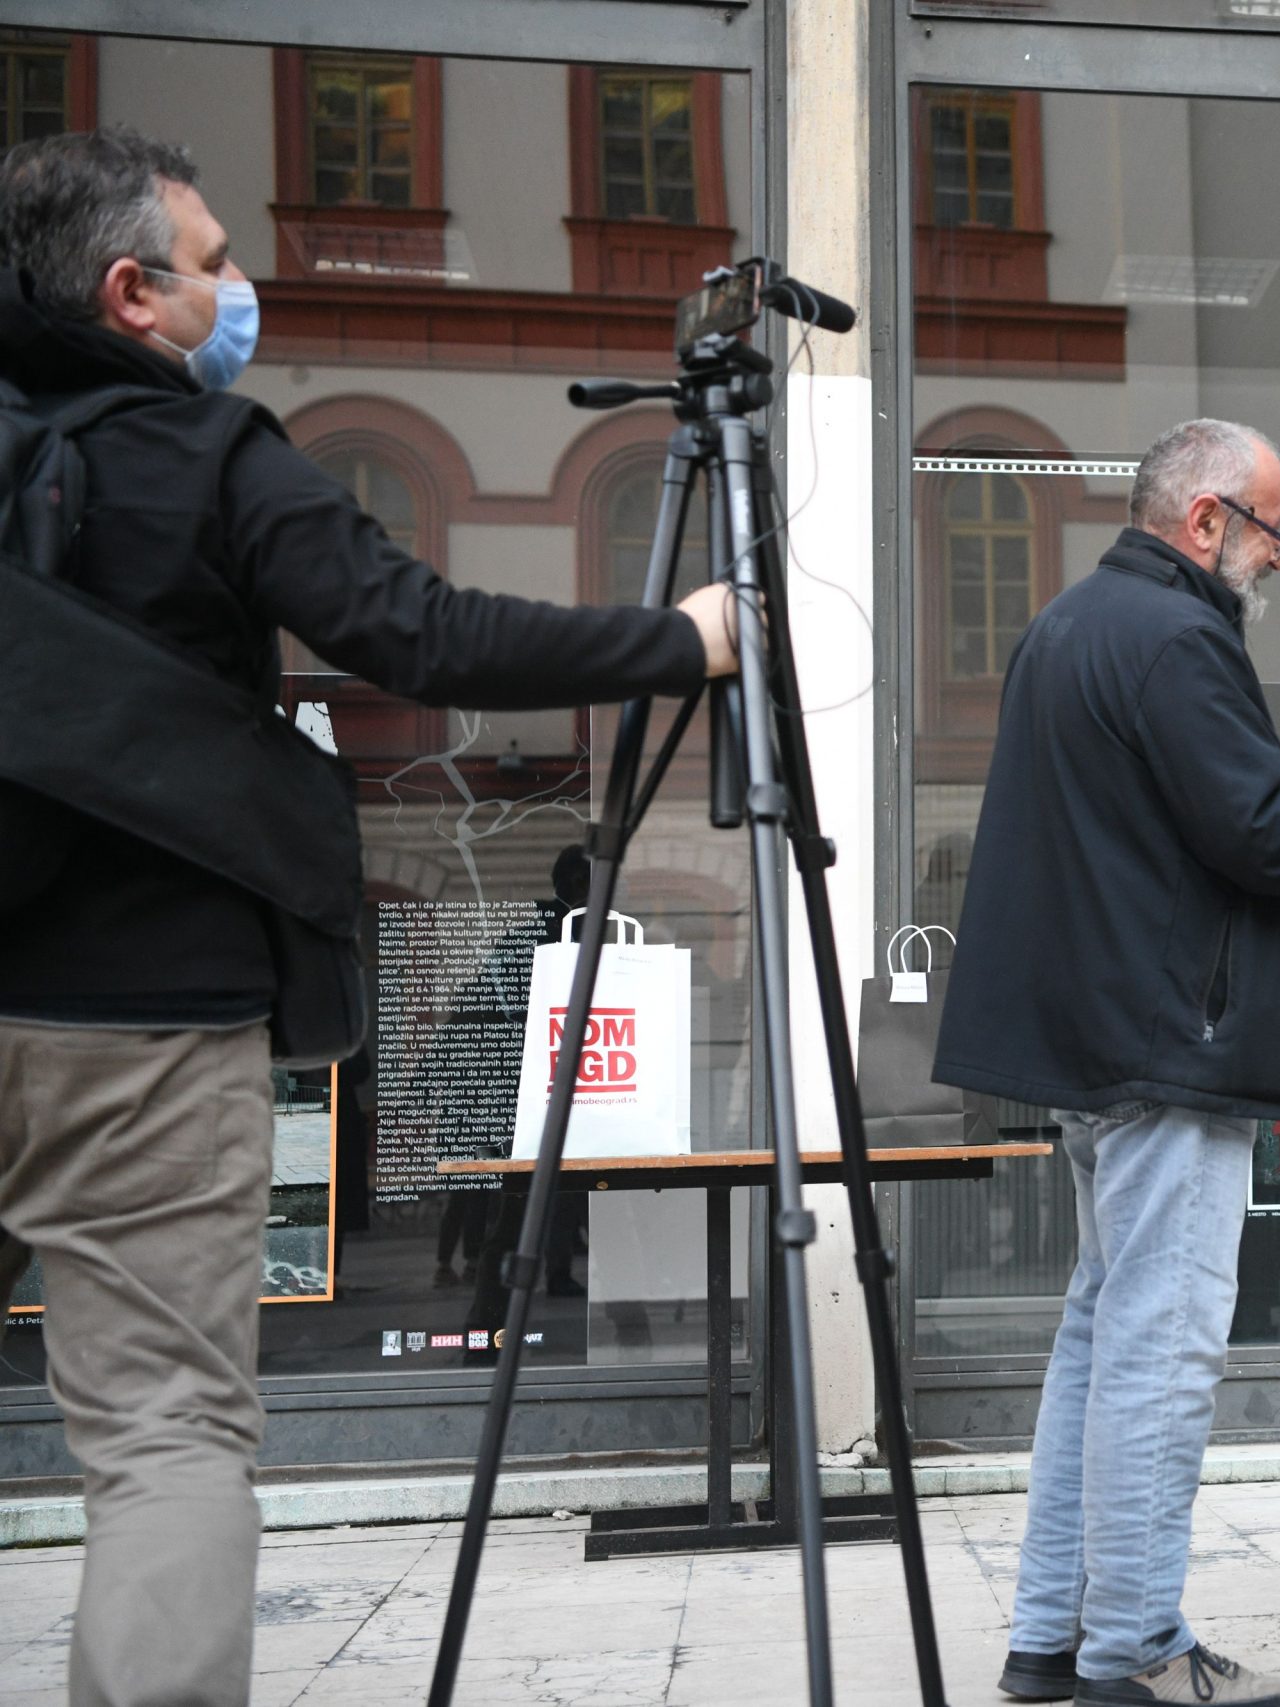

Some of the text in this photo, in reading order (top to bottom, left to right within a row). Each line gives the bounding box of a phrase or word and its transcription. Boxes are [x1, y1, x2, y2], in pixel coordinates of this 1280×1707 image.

[435, 901, 443, 910] je
[492, 900, 499, 910] je
[520, 910, 542, 919] mogli
[407, 929, 451, 938] spomenika
[483, 928, 506, 937] grada
[409, 938, 437, 947] prostor
[494, 937, 537, 947] Filozofskog
[416, 948, 440, 957] spada
[378, 957, 412, 966] istorijske
[447, 966, 475, 975] rešenja
[378, 976, 422, 985] spomenika
[455, 975, 478, 984] grada
[480, 975, 518, 984] Beograda
[467, 984, 492, 994] manje
[378, 994, 409, 1004] površini
[444, 1004, 460, 1013] ovoj
[462, 1003, 493, 1012] površini
[483, 1022, 522, 1031] inspekcija
[416, 1032, 448, 1041] sanaciju
[378, 1051, 423, 1060] informaciju
[449, 1050, 480, 1060] gradske
[421, 1060, 443, 1069] svojih
[378, 1070, 425, 1079] prigradskim
[412, 1078, 448, 1088] značajno
[450, 1078, 484, 1088] povećala
[487, 1078, 516, 1087] gustina
[428, 1087, 464, 1098] Sučeljeni
[477, 1087, 514, 1097] opcijama
[377, 1098, 415, 1108] smejemo
[477, 1096, 506, 1104] odlučili
[377, 1109, 395, 1117] prvu
[447, 1107, 468, 1116] Zbog
[470, 1106, 488, 1116] toga
[490, 1106, 497, 1116] je
[462, 1115, 506, 1125] Filozofskog
[428, 1126, 458, 1135] saradnji
[376, 1183, 400, 1193] uspeti
[432, 1335, 463, 1346] НИН
[469, 1332, 488, 1340] NDM
[469, 1340, 488, 1348] BGD
